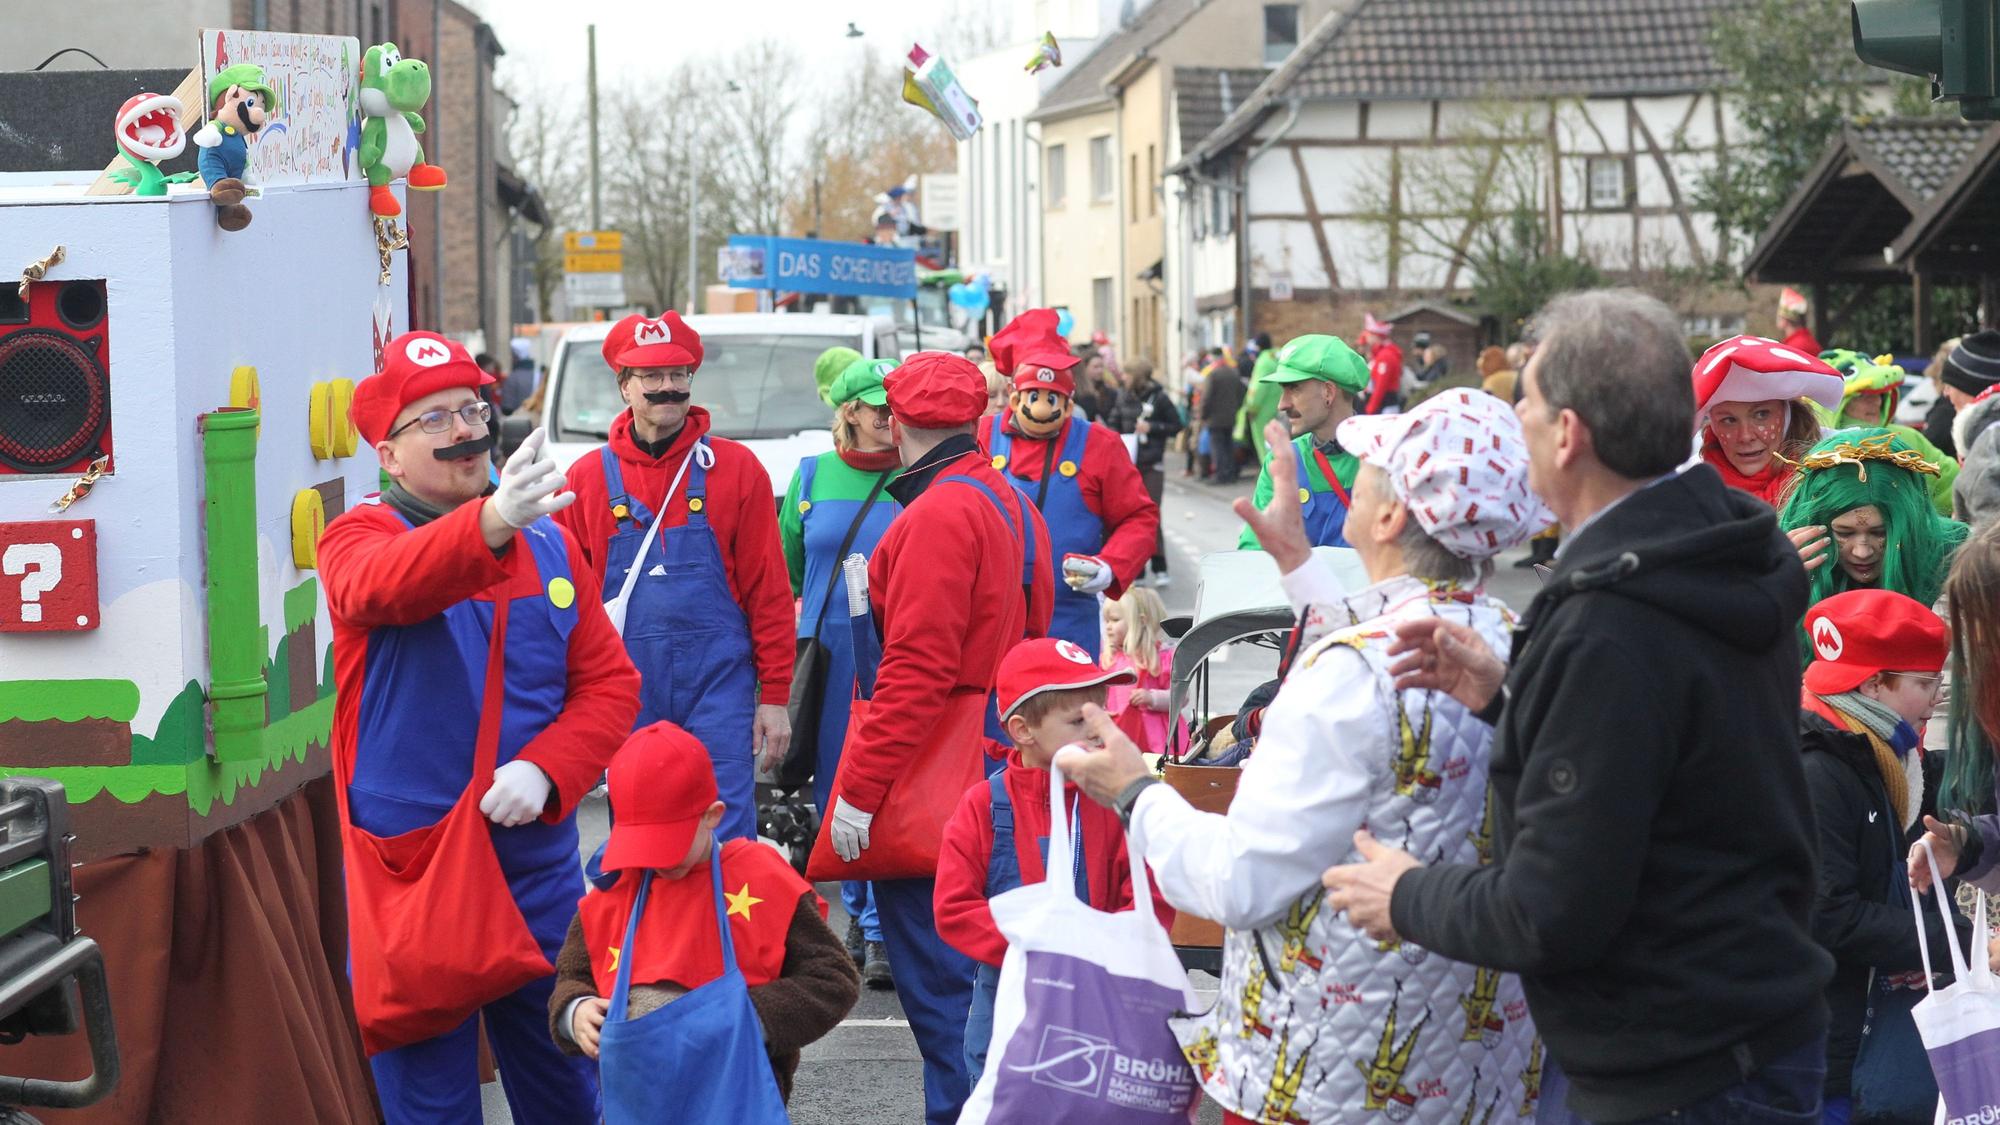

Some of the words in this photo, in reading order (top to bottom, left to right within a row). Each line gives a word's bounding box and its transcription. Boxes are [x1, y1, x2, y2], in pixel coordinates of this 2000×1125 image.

[779, 251, 821, 279] DAS
[640, 323, 667, 340] M
[417, 345, 444, 360] M
[1039, 370, 1052, 380] M
[2, 542, 62, 622] ?
[1817, 625, 1839, 651] M
